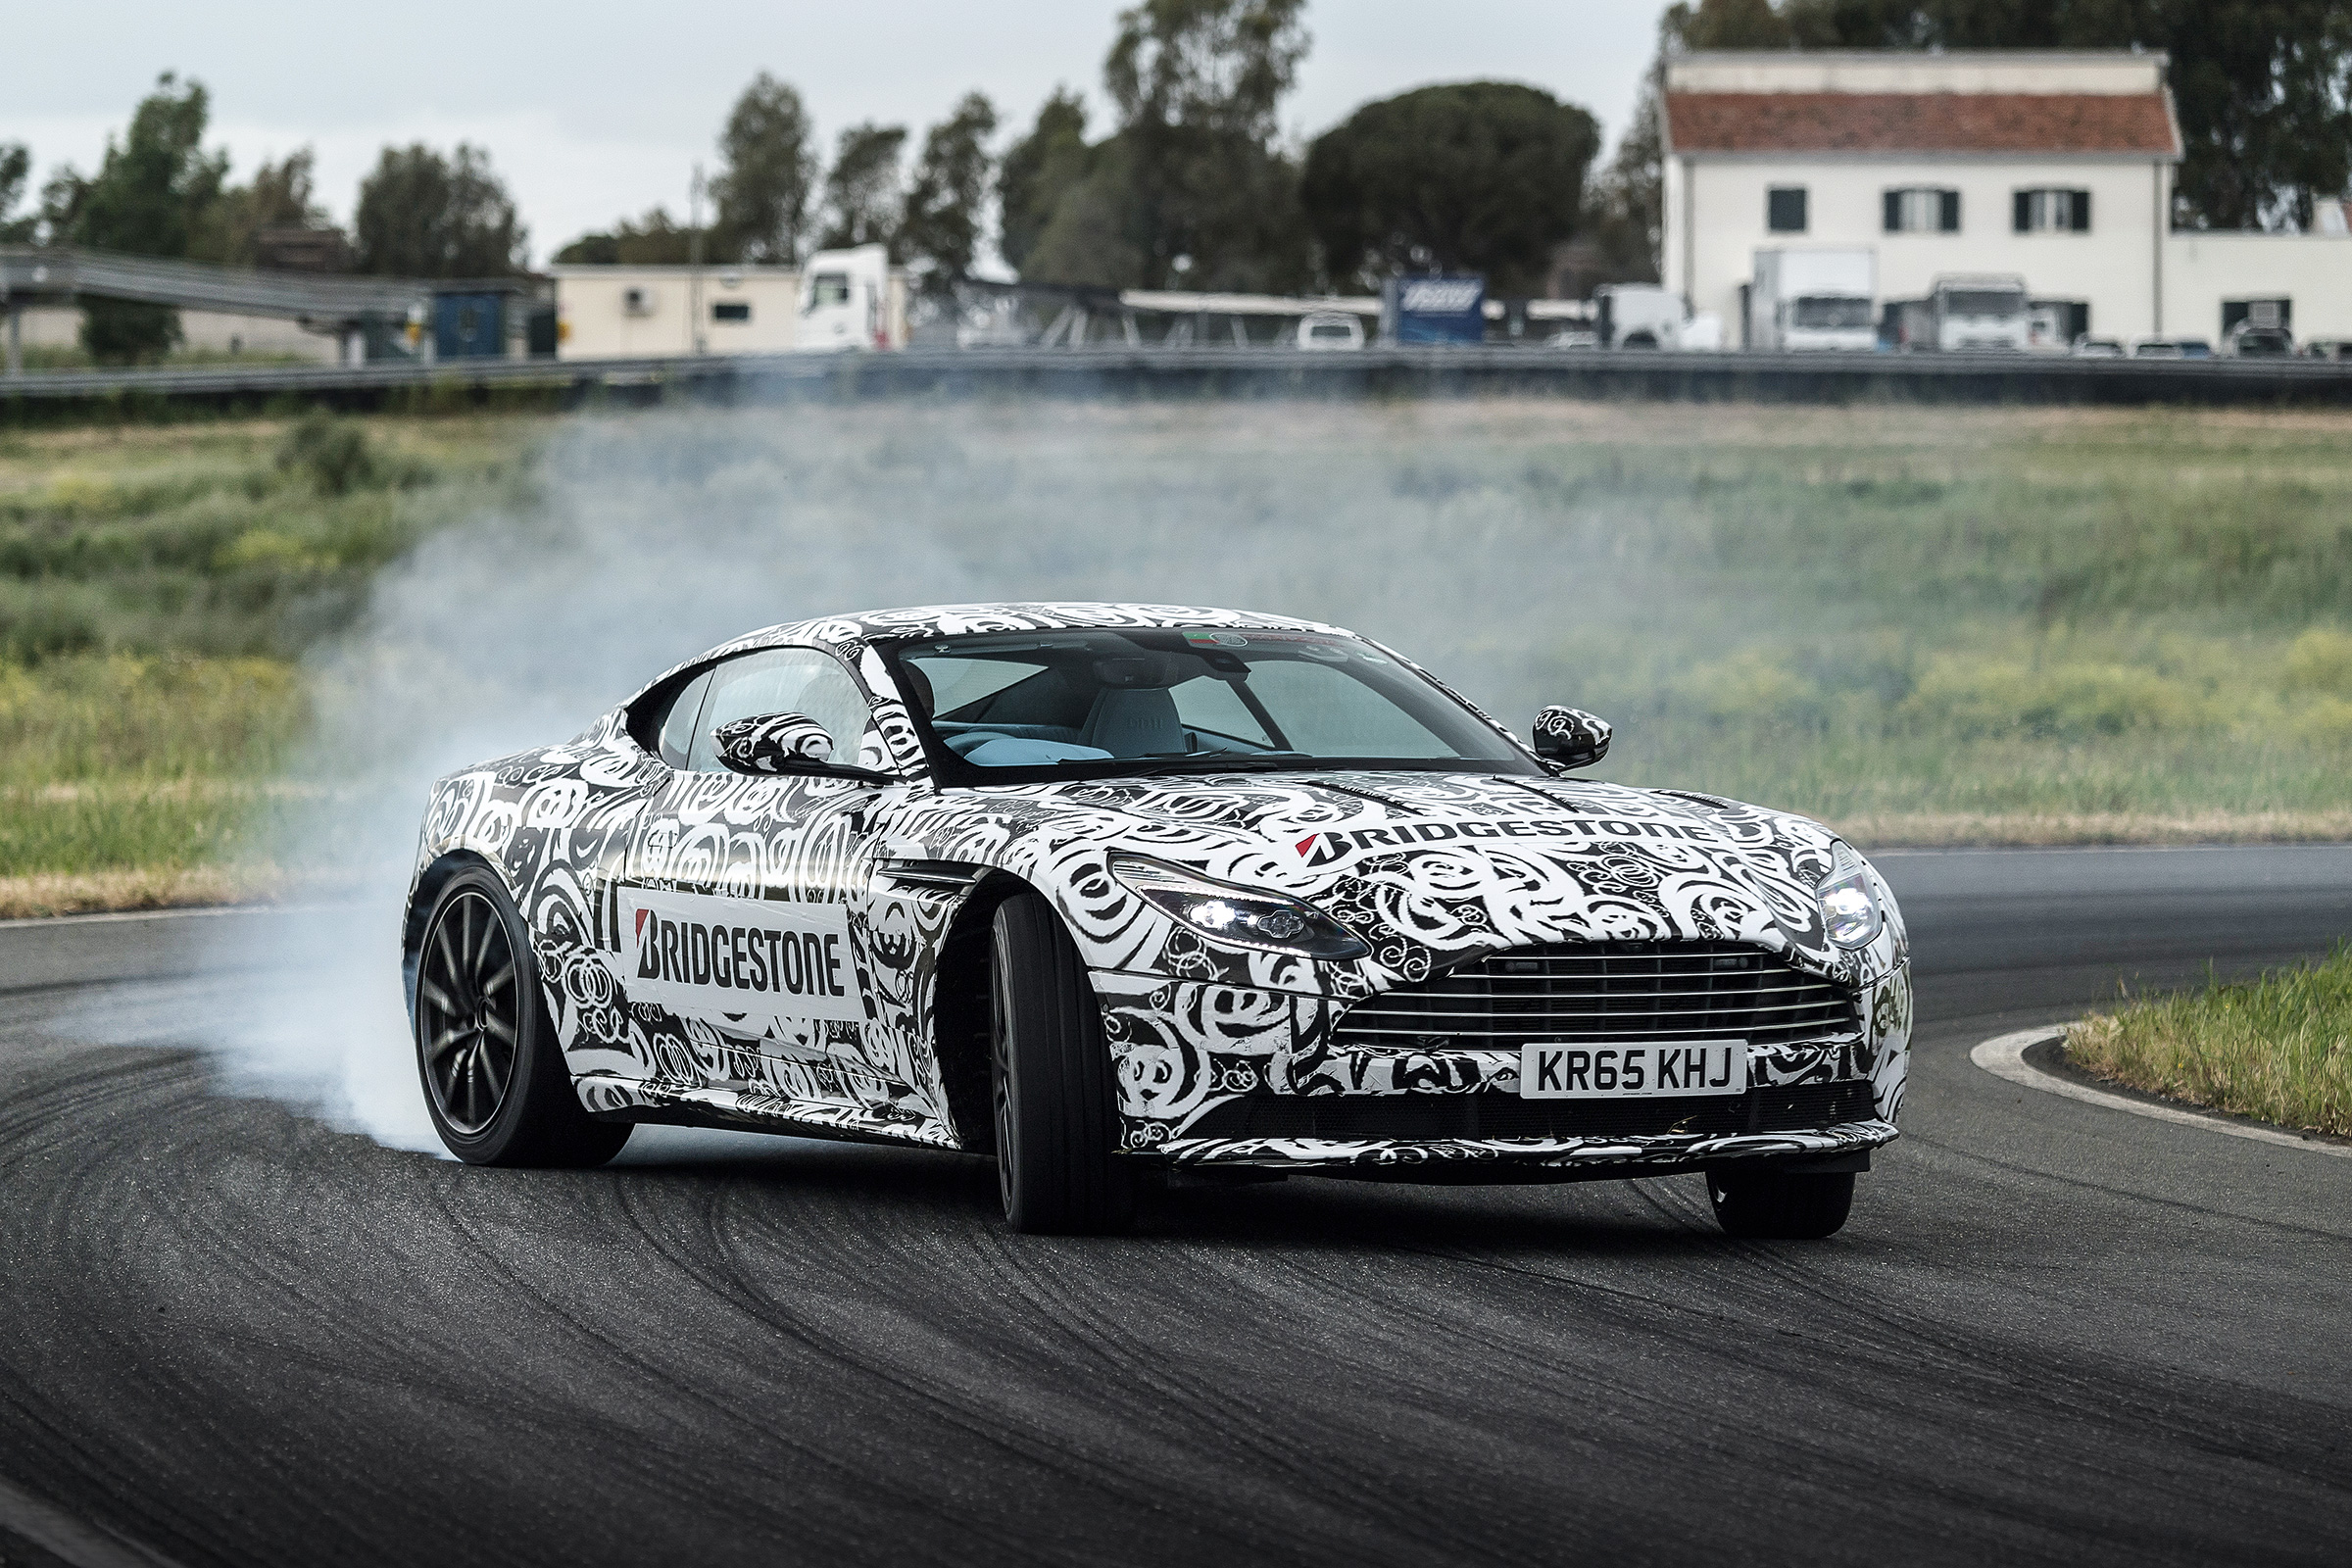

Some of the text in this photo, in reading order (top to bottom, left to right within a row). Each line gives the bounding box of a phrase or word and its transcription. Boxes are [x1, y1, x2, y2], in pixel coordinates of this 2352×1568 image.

[1296, 819, 1719, 867] BRIDGESTONE
[635, 908, 845, 997] BRIDGESTONE
[1538, 1047, 1732, 1091] KR65 KHJ
